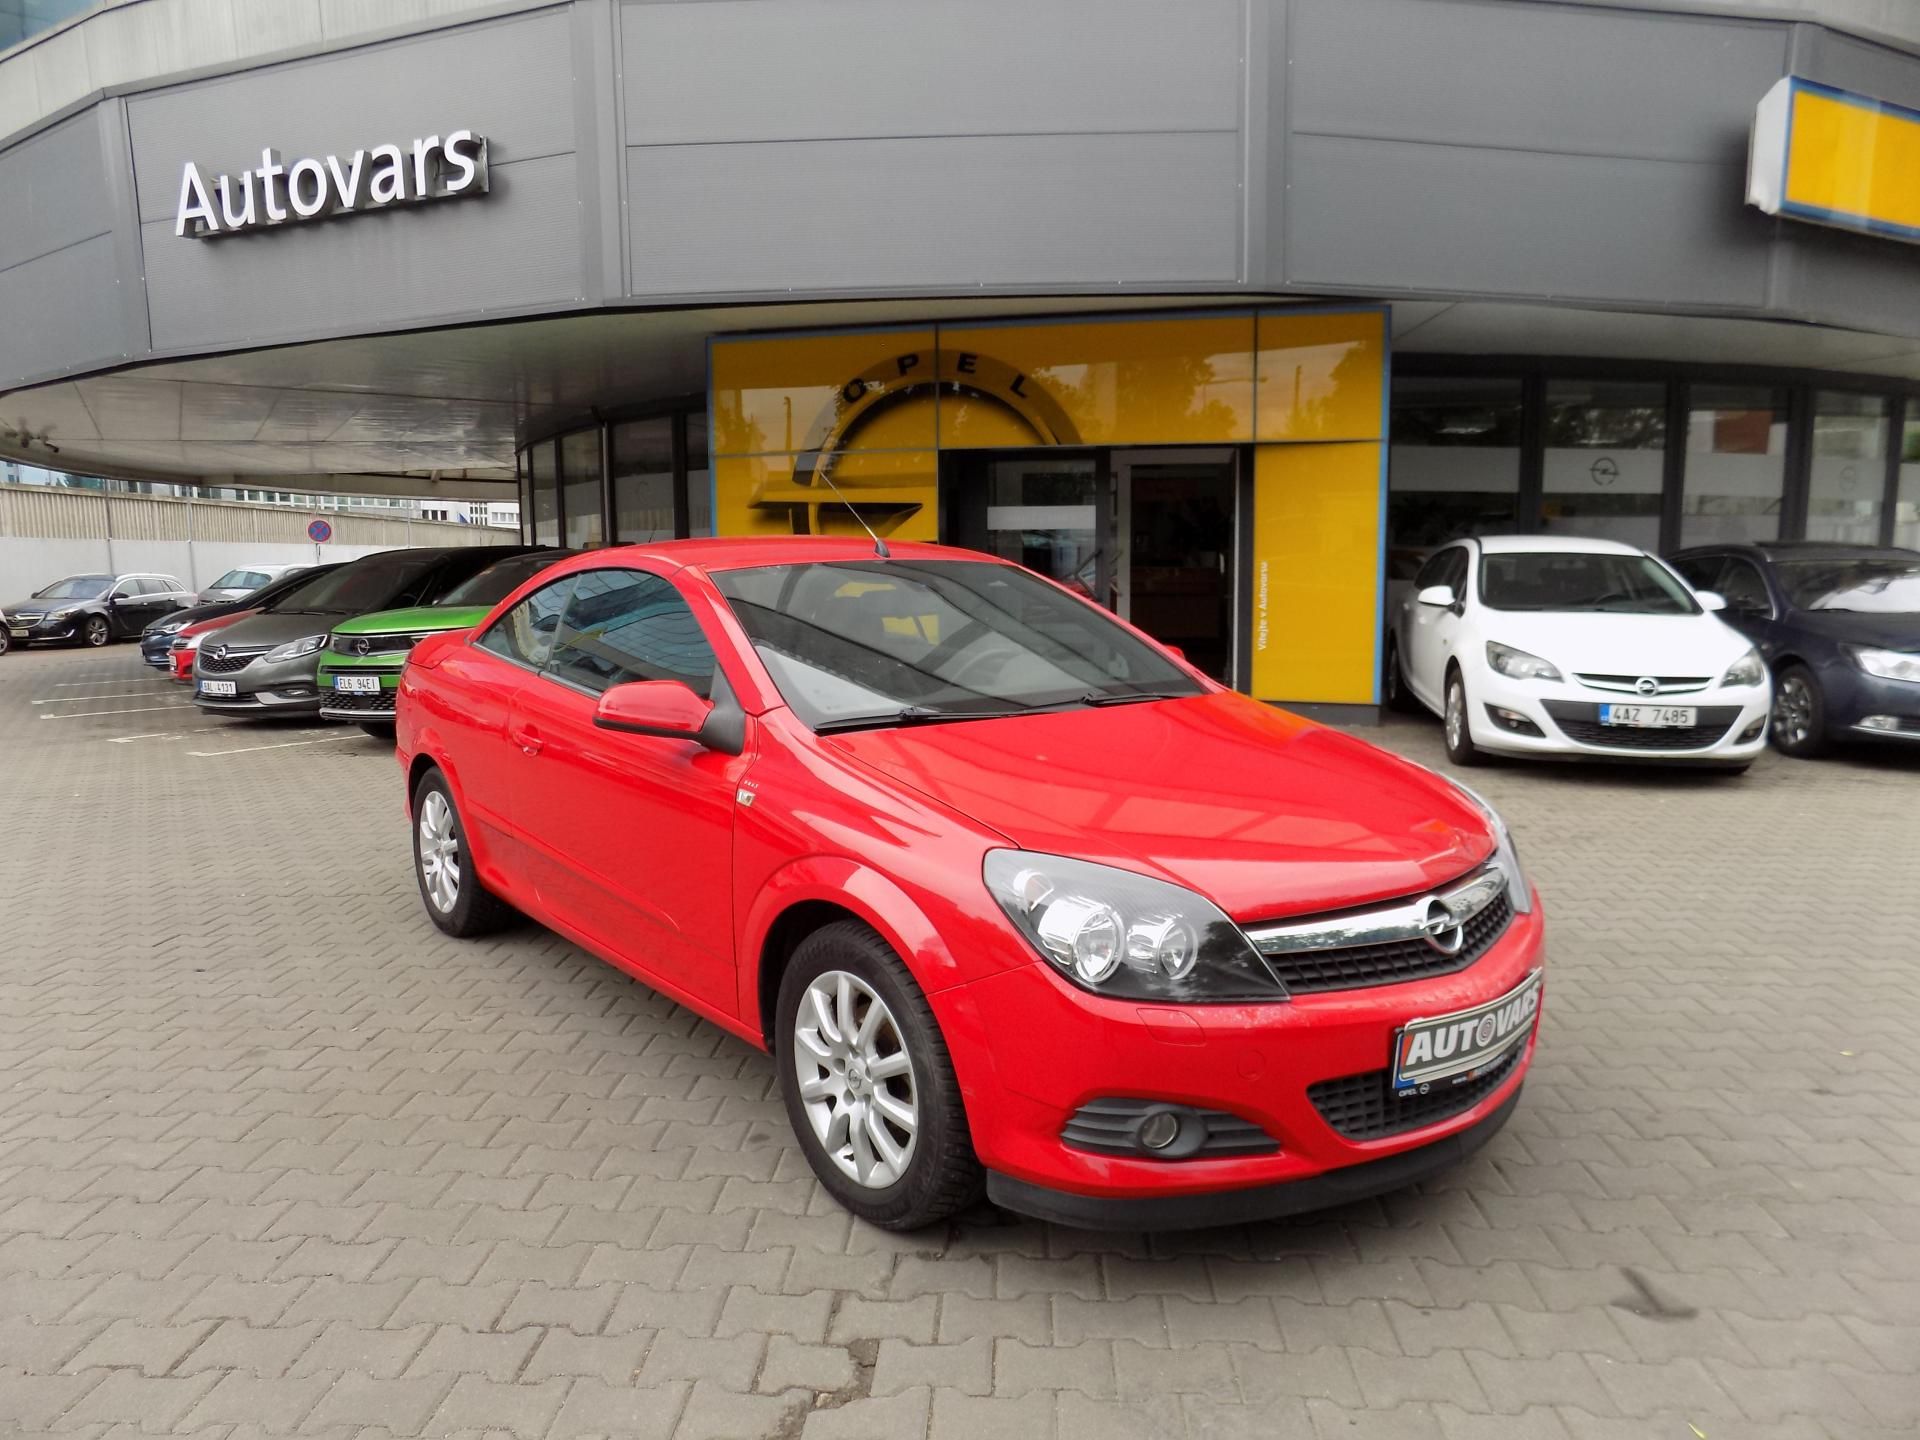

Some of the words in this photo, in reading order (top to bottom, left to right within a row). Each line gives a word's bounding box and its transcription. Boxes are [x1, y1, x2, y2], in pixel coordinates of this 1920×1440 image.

[175, 129, 477, 236] Autovars
[843, 352, 1029, 404] OPEL
[1613, 707, 1641, 722] 4AZ
[1652, 709, 1689, 724] 7485
[1405, 980, 1540, 1066] AUTOVARS
